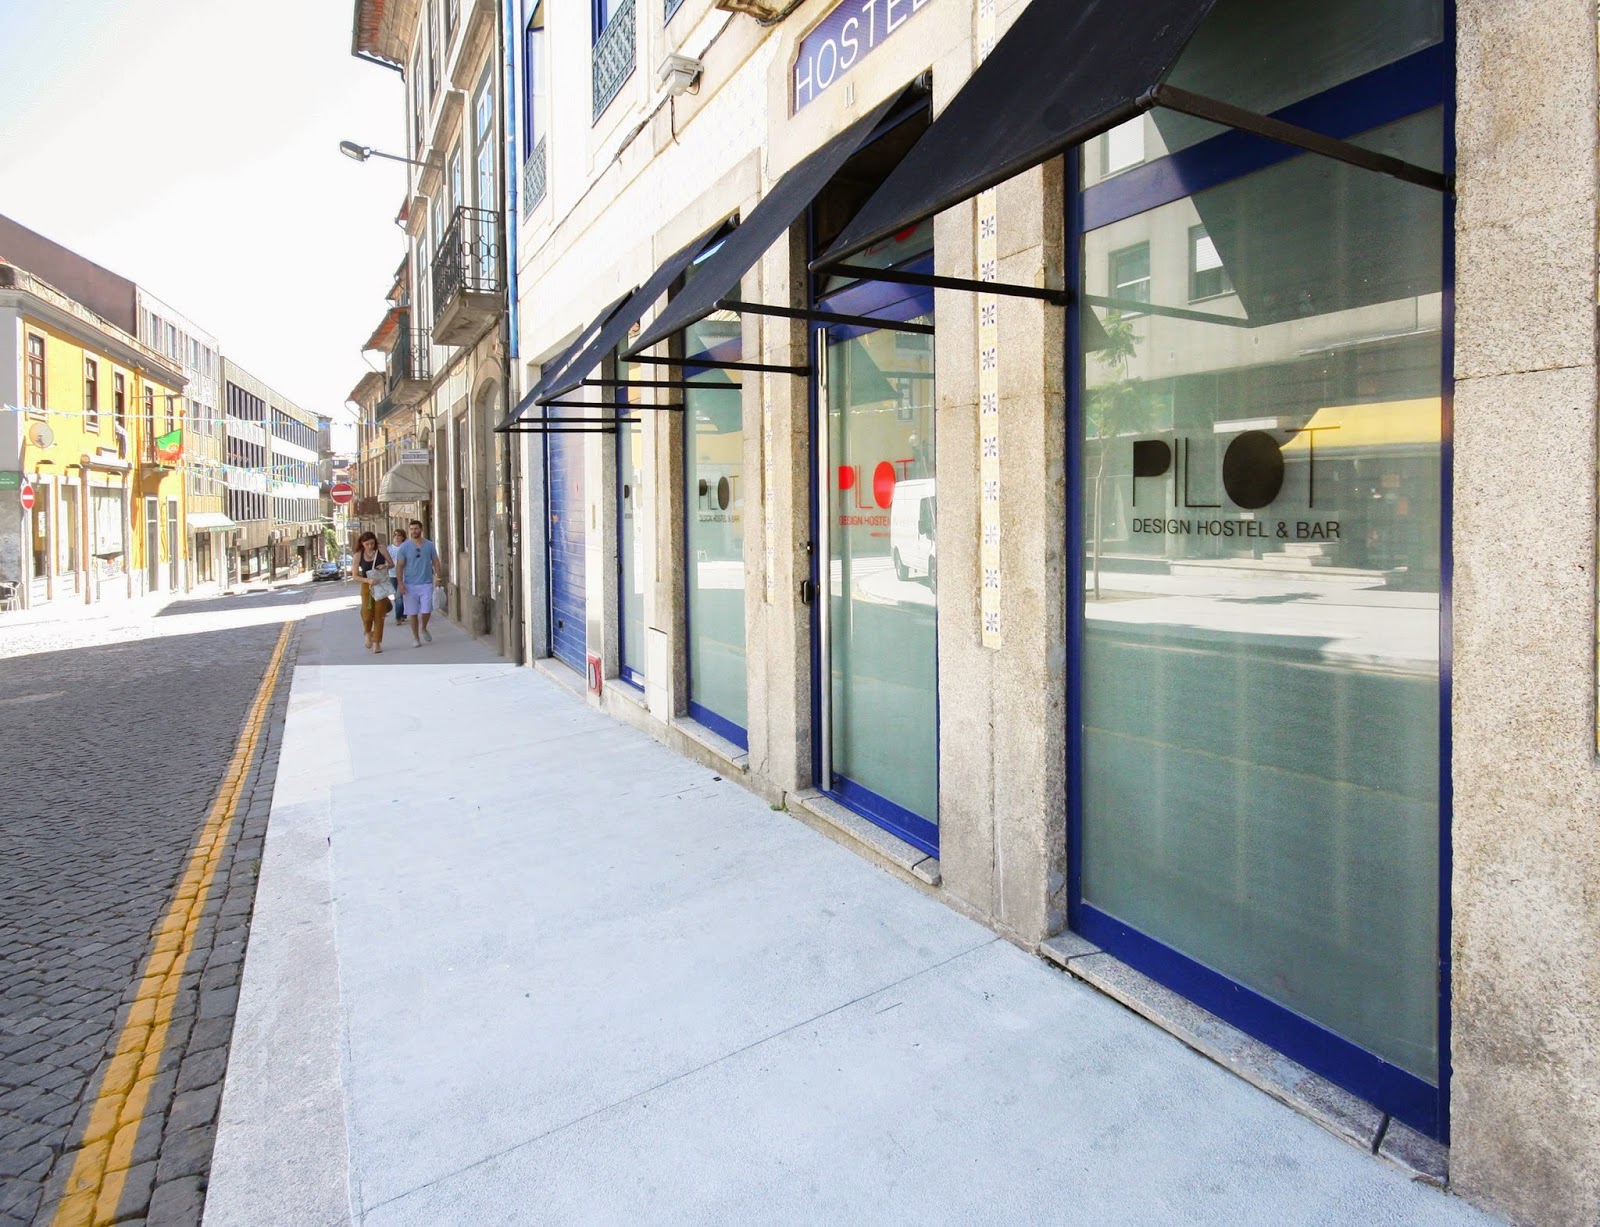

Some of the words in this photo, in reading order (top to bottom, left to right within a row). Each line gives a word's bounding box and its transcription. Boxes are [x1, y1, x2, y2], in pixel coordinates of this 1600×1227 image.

[796, 0, 927, 111] HOSTE
[1133, 426, 1341, 509] PILOT
[839, 515, 862, 526] DESIGN
[1132, 518, 1191, 535] DESIGN
[1196, 519, 1269, 539] HOSTEL
[1275, 521, 1289, 539] &
[1296, 521, 1341, 539] BAR
